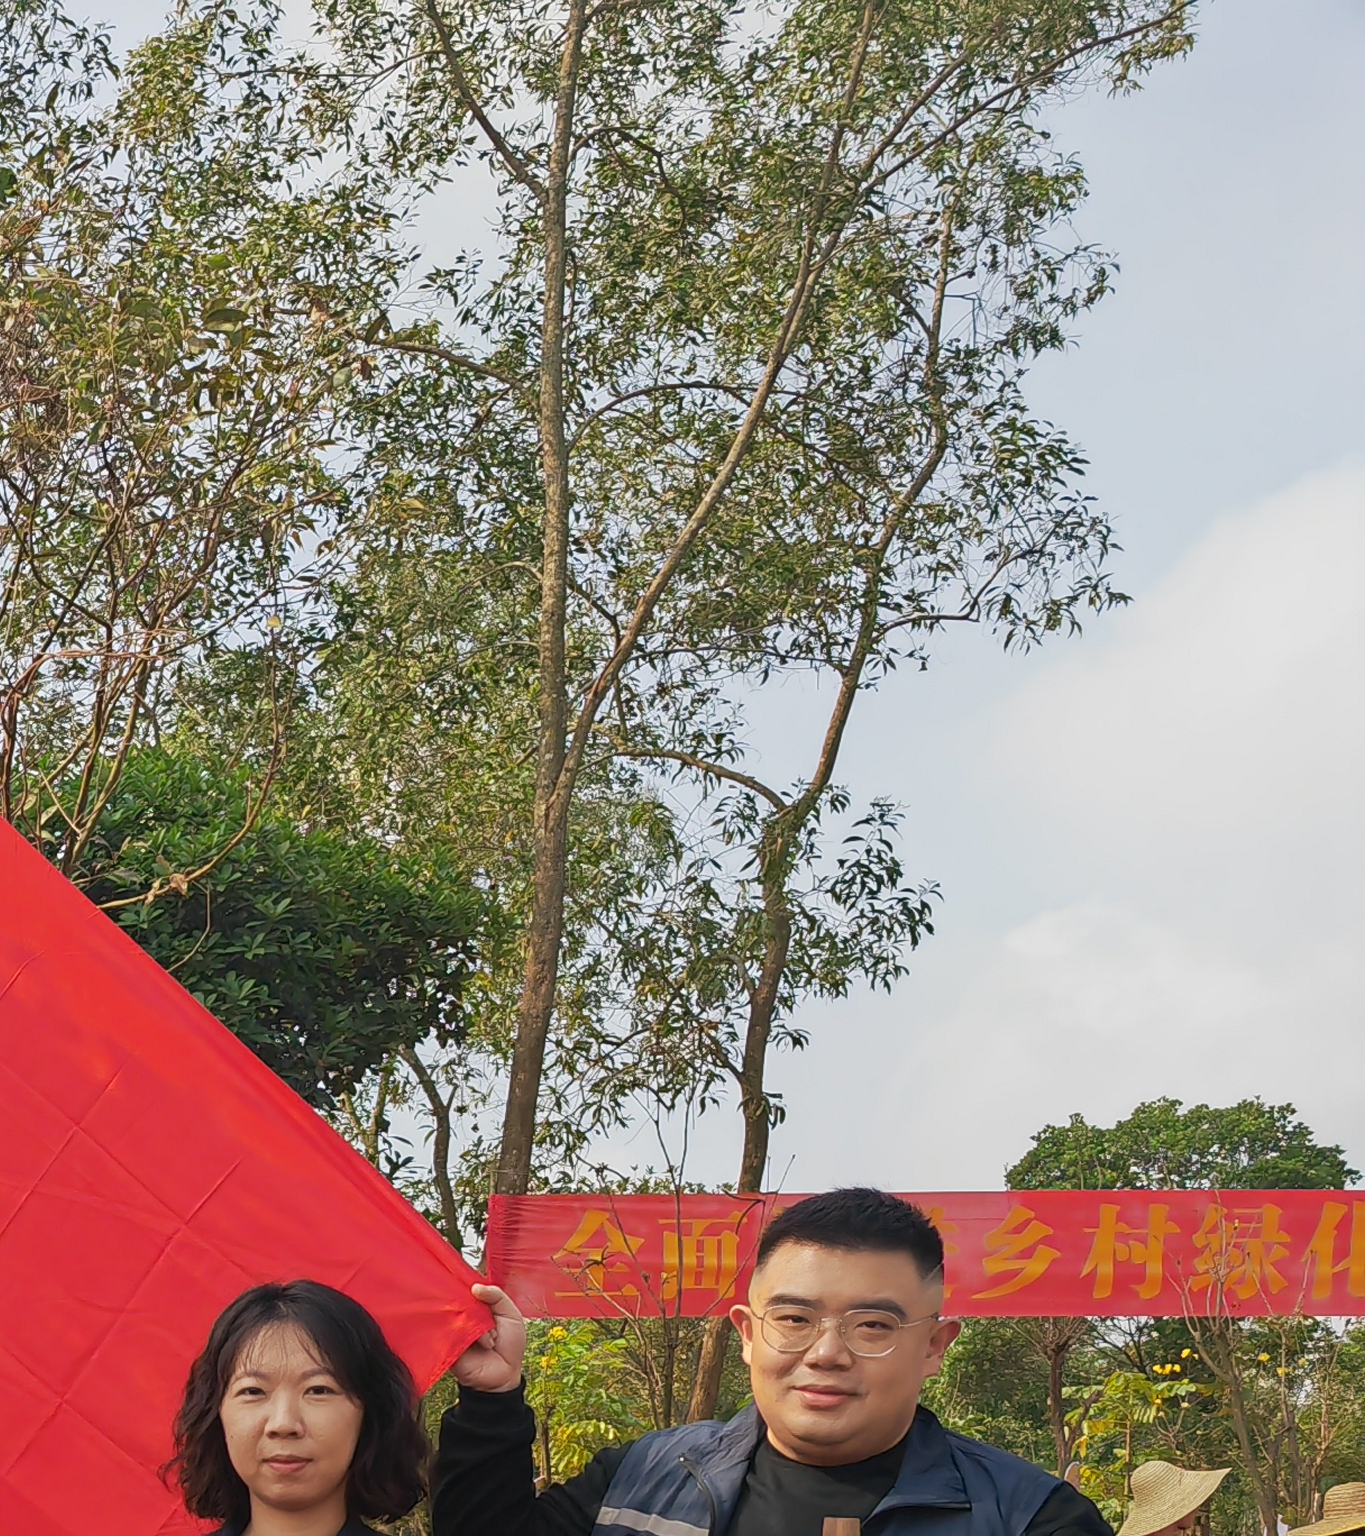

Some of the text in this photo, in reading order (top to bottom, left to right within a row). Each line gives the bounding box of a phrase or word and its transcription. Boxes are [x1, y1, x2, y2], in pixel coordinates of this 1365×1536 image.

[551, 1201, 1365, 1300] 全面乡村绿化
